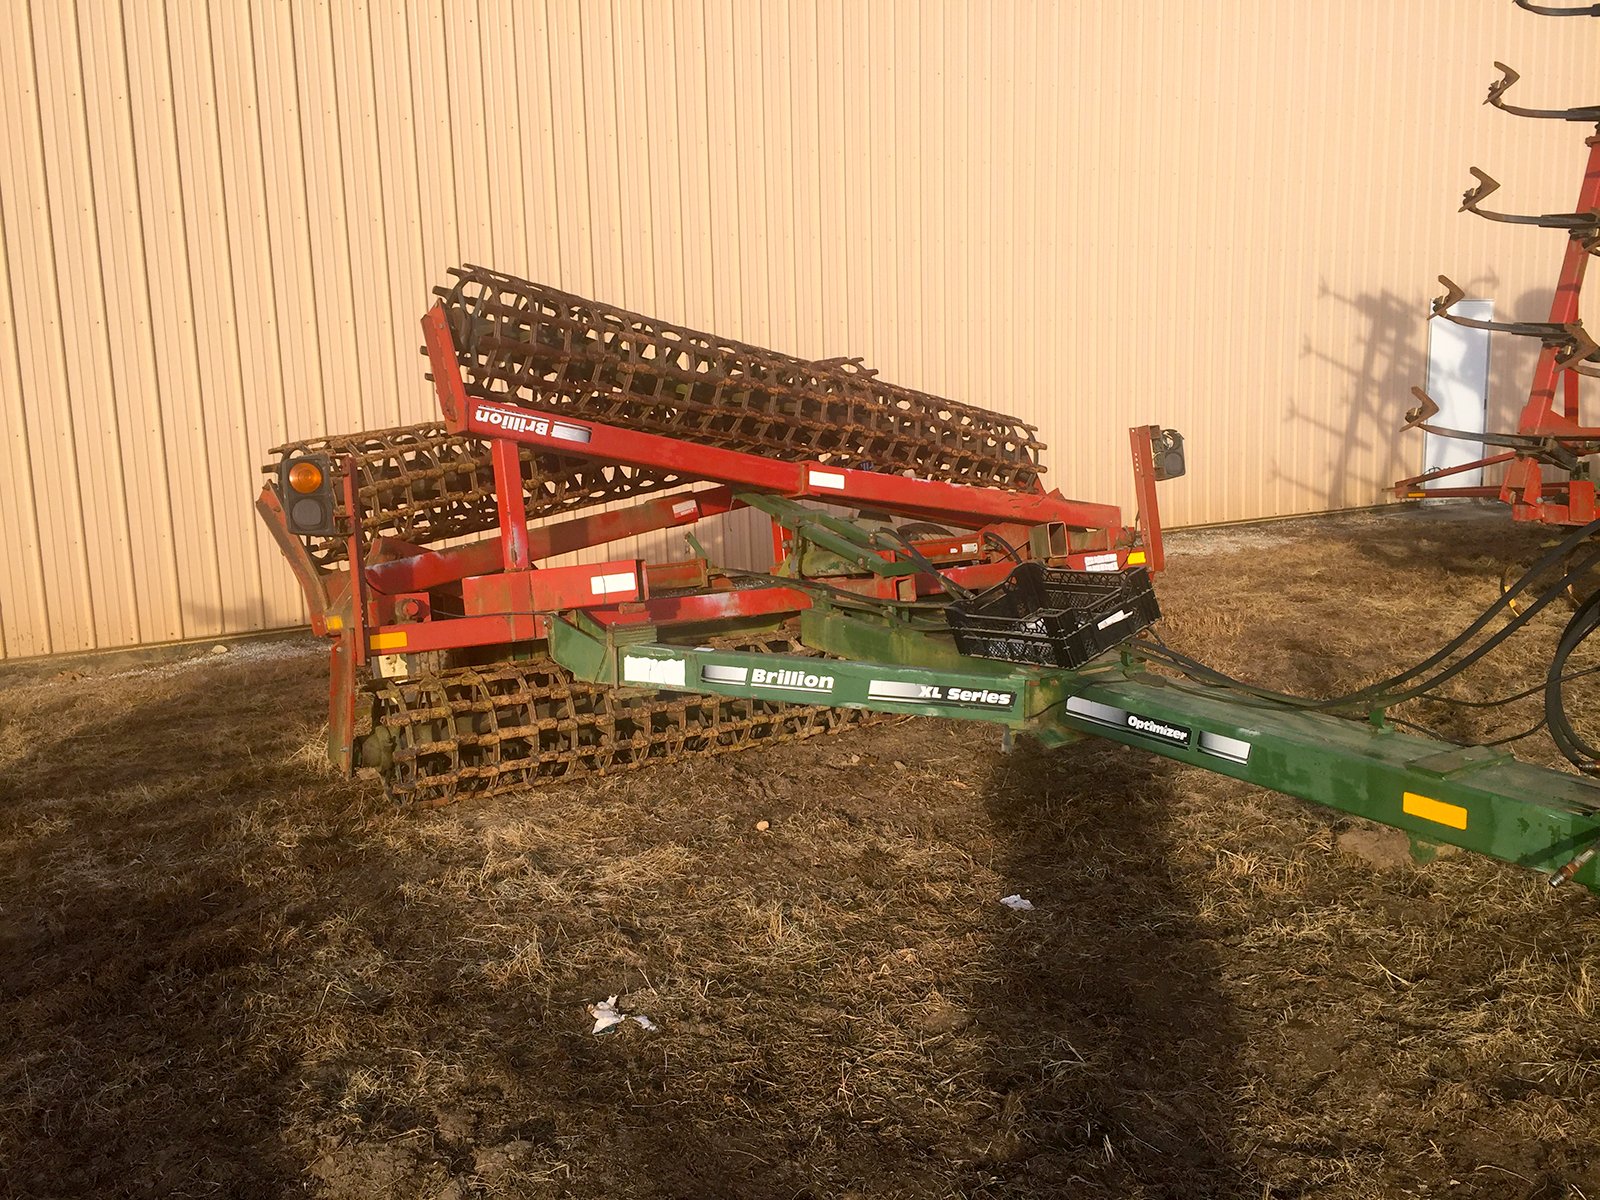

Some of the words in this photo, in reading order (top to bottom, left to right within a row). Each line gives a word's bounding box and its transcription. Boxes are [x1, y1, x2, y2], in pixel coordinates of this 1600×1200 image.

[475, 410, 549, 435] Brillion
[751, 667, 834, 691] Brillion
[918, 685, 942, 700] XL
[946, 687, 1011, 705] Series
[1127, 715, 1188, 741] Optimizer
